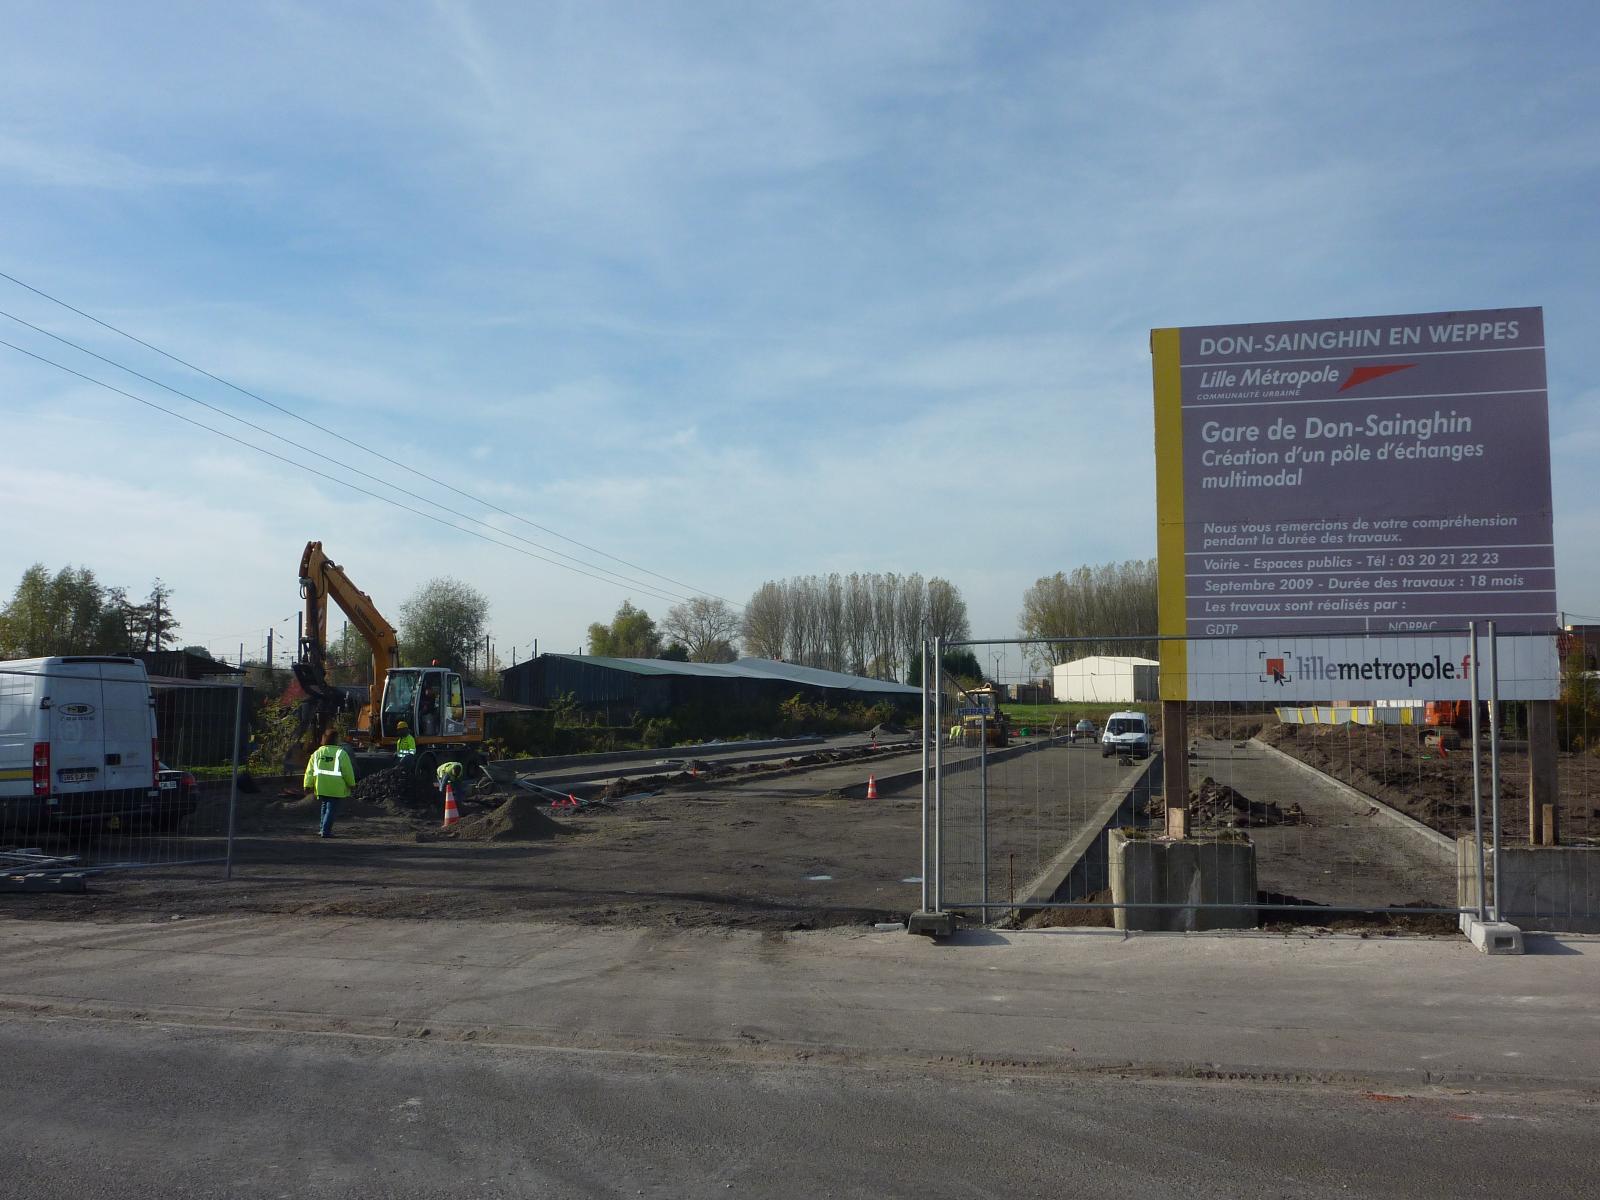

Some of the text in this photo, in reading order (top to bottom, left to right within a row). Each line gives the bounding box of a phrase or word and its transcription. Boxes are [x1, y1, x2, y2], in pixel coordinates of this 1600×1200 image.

[1200, 321, 1518, 355] DON-SAINGHIN EN WEPPES
[1200, 365, 1339, 388] Lille Métropole
[1202, 411, 1471, 442] Gare de Don-Sainghin
[1202, 447, 1278, 466] Création
[1331, 444, 1370, 466] pôle
[1203, 468, 1302, 488] multimodal
[1204, 514, 1517, 533] Nous vous remercions de votre compréhension
[1204, 532, 1401, 549] pendant la durée des travaux.
[1204, 559, 1240, 569] Voirie
[1254, 558, 1303, 571] Espaces
[1307, 556, 1352, 570] publics
[1367, 555, 1385, 566] Tél
[1399, 555, 1414, 565] 03
[1419, 554, 1435, 565] 20
[1440, 554, 1454, 564] 21
[1461, 554, 1477, 564] 22
[1482, 553, 1498, 564] 23
[1205, 579, 1275, 593] Septembre
[1280, 579, 1313, 589] 2009
[1329, 578, 1369, 589] Durée
[1374, 577, 1397, 588] des
[1402, 578, 1455, 587] travaux
[1471, 575, 1486, 586] 18
[1491, 574, 1523, 586] mois
[1205, 601, 1226, 612] Les
[1230, 602, 1280, 611] travaux
[1285, 601, 1313, 611] sont
[1318, 599, 1369, 610] réalisés
[1374, 600, 1397, 612] par
[1206, 624, 1238, 635] GDTP
